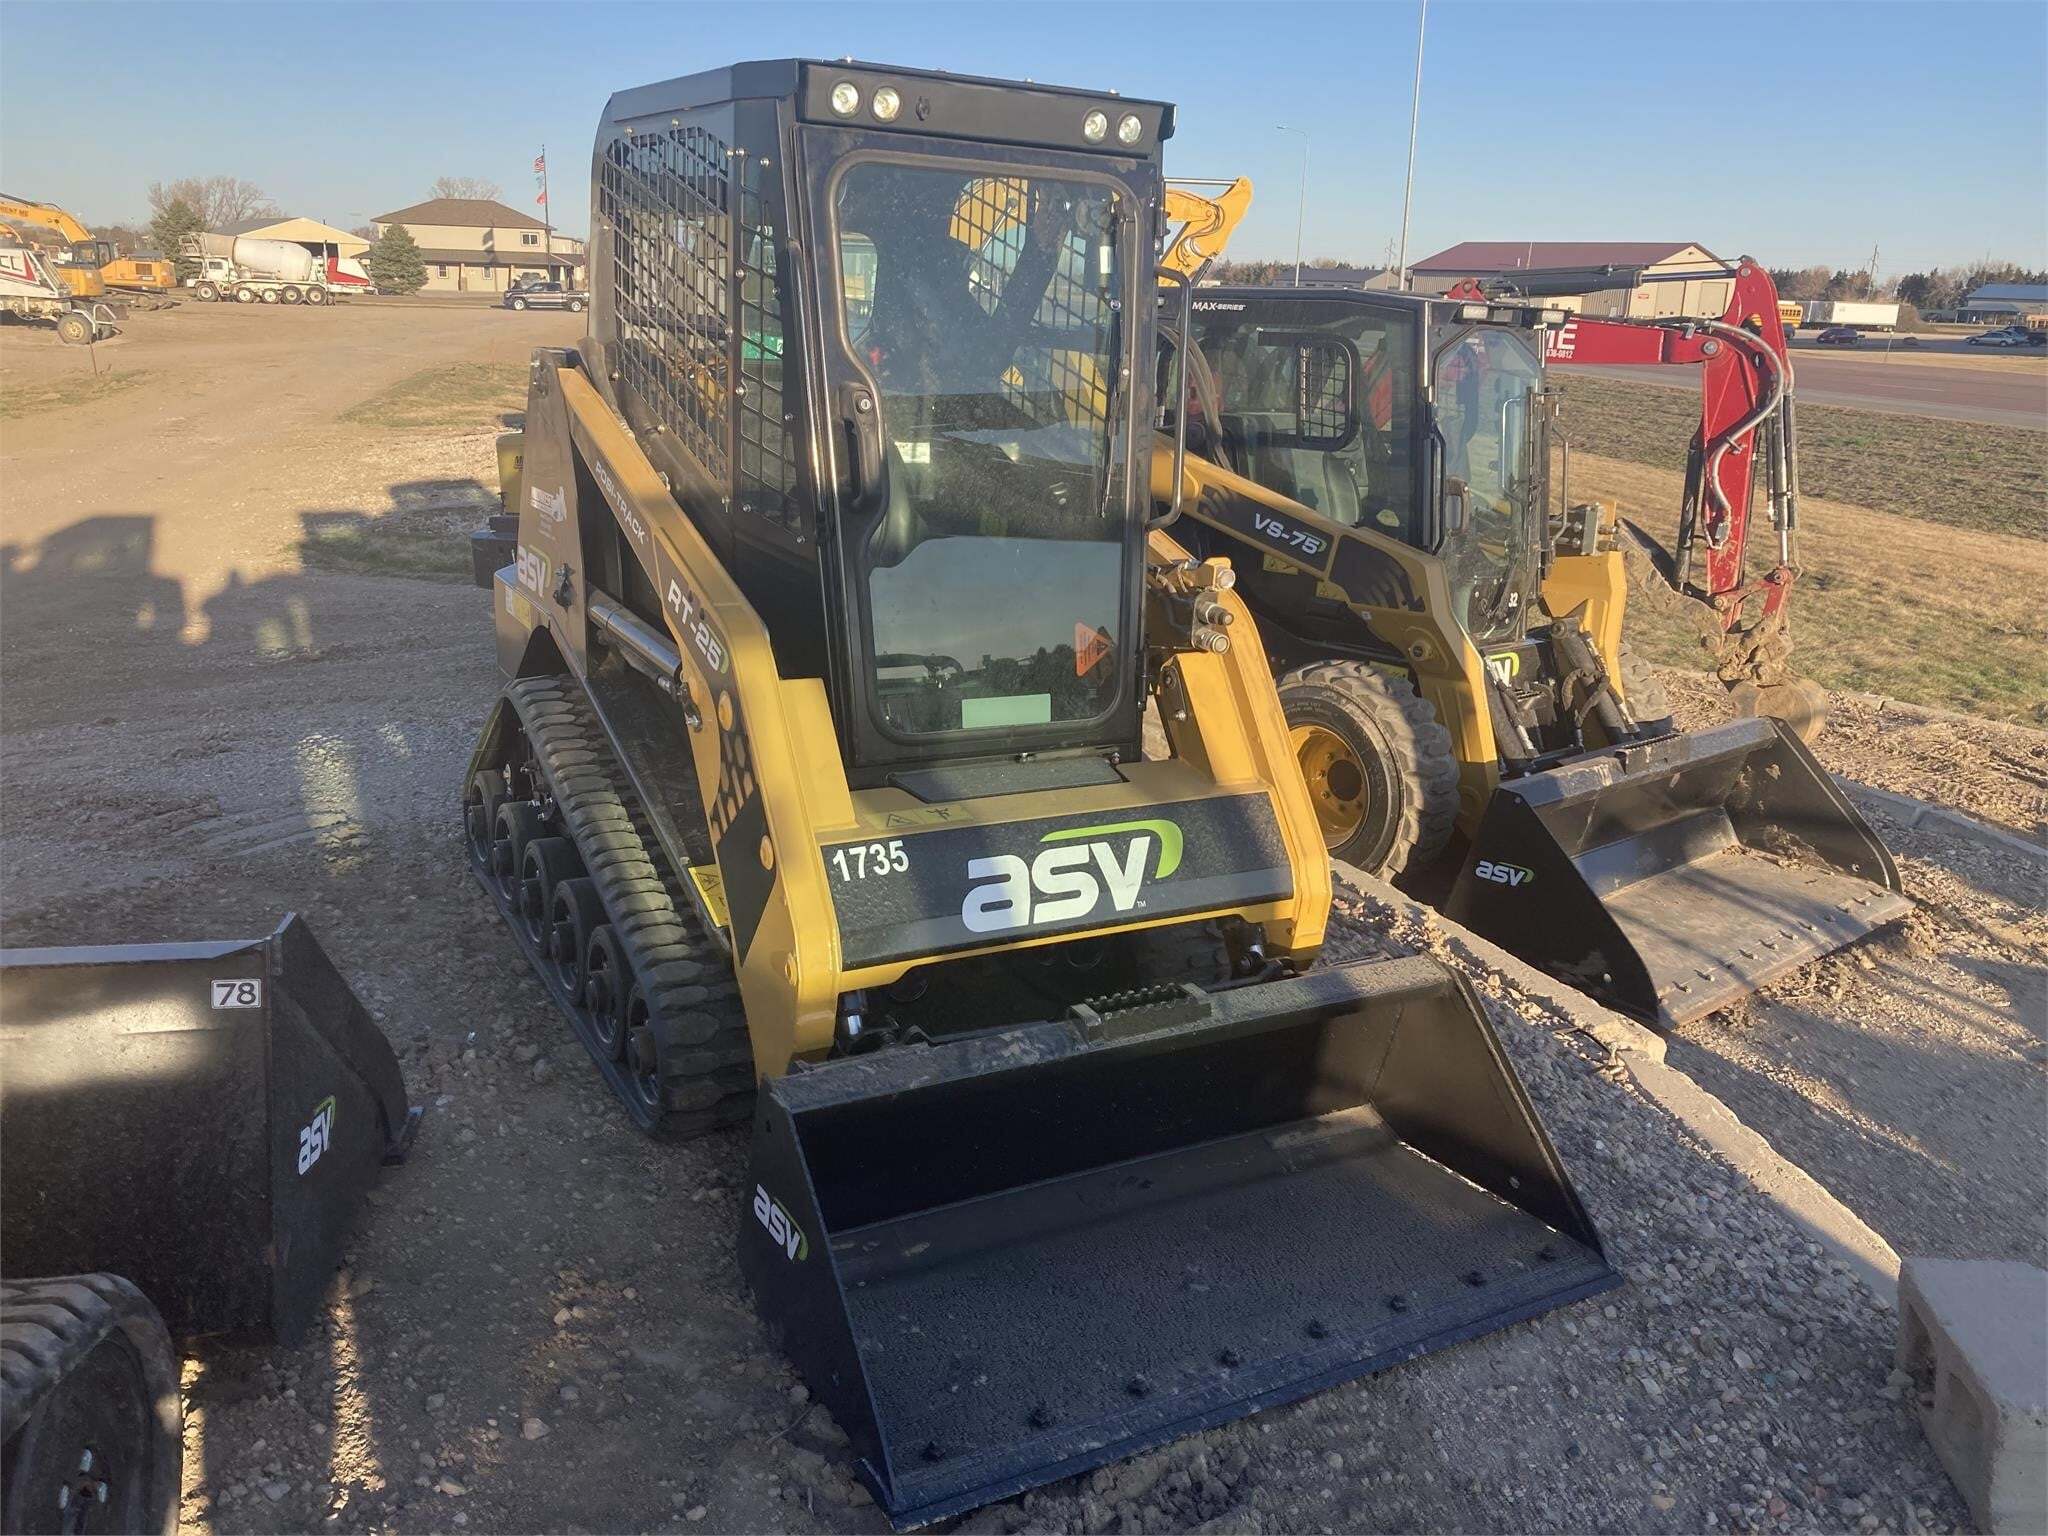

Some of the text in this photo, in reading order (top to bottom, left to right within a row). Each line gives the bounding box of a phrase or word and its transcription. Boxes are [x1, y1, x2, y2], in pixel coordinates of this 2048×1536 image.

[594, 460, 646, 545] POSI-TRACK
[1255, 512, 1321, 555] VS-75
[667, 578, 723, 673] RT-25
[832, 839, 910, 882] 1735
[215, 981, 258, 1007] 78
